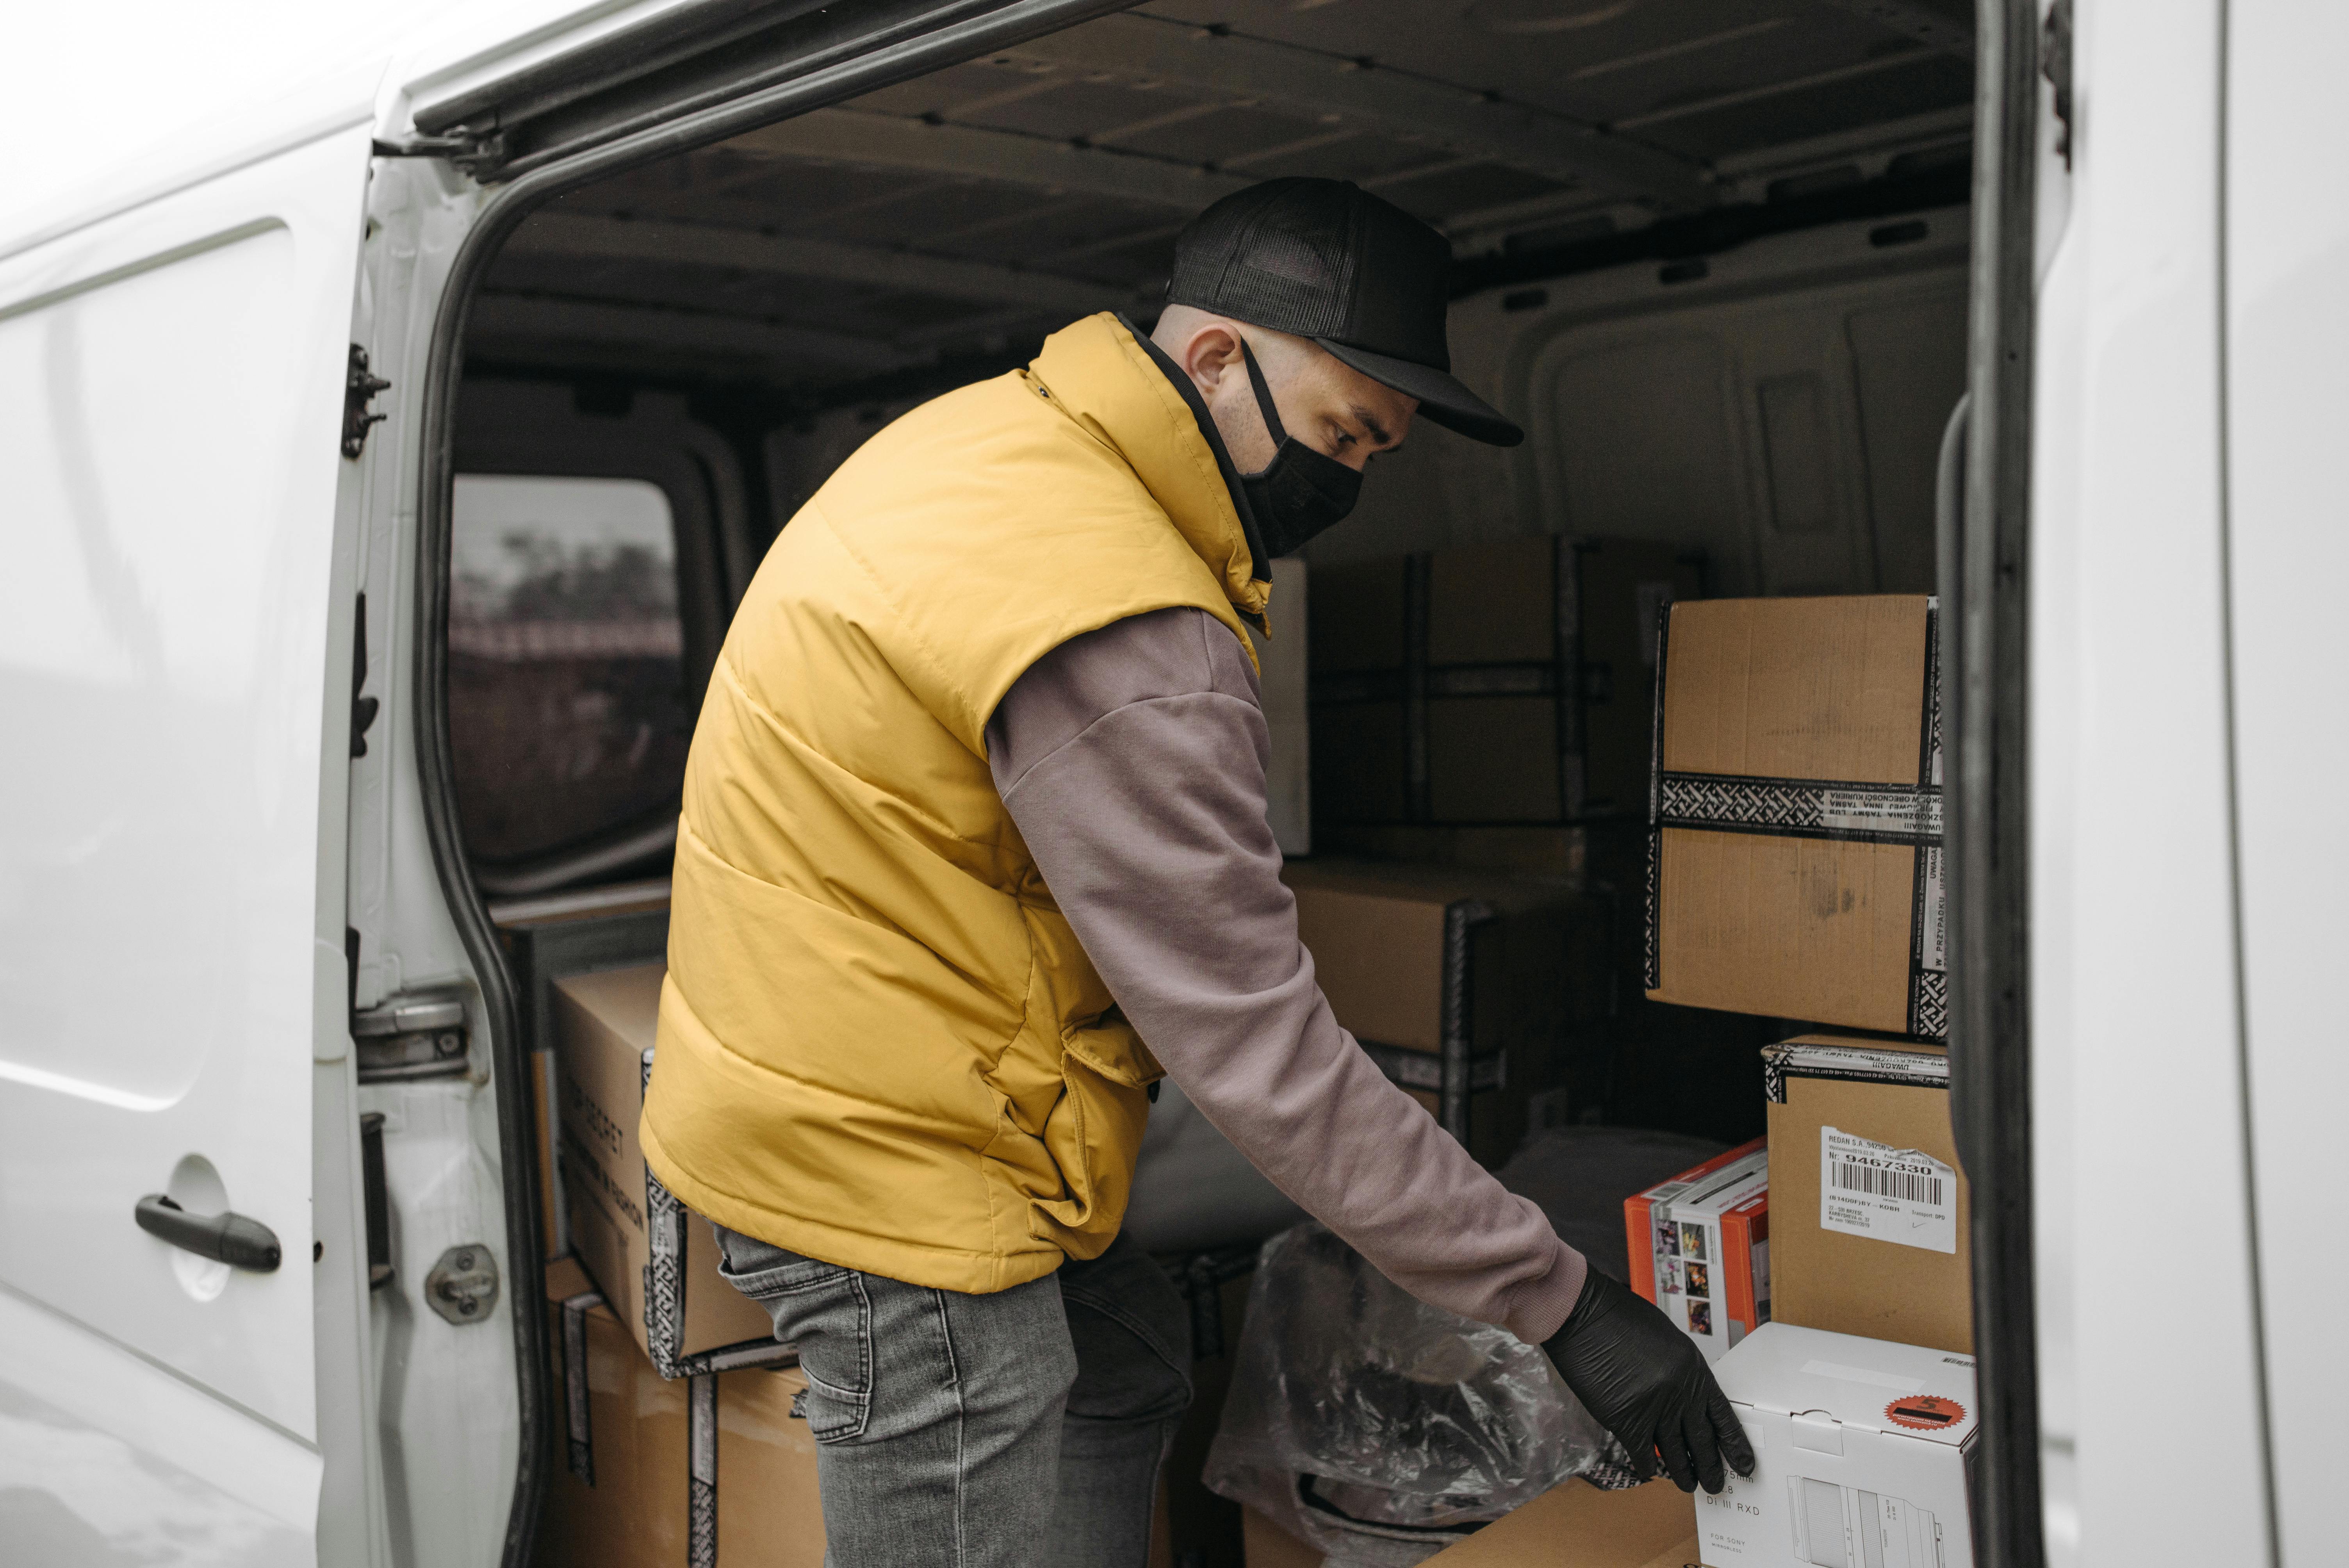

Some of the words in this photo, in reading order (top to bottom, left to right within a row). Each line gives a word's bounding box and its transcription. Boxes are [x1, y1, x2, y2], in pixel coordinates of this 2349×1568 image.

[1830, 792, 1862, 800] KURIERA
[1936, 896, 1944, 952] PRZYPADKU
[1936, 958, 1942, 966] W
[1829, 1135, 1850, 1145] REDAN
[1829, 1151, 1839, 1160] Nr:
[1846, 1154, 1931, 1175] 9467330
[1912, 1210, 1934, 1219] Transport:
[1721, 1486, 1733, 1494] .8
[1707, 1496, 1717, 1506] Di
[1738, 1503, 1759, 1515] RXD
[1727, 1537, 1745, 1547] SONY
